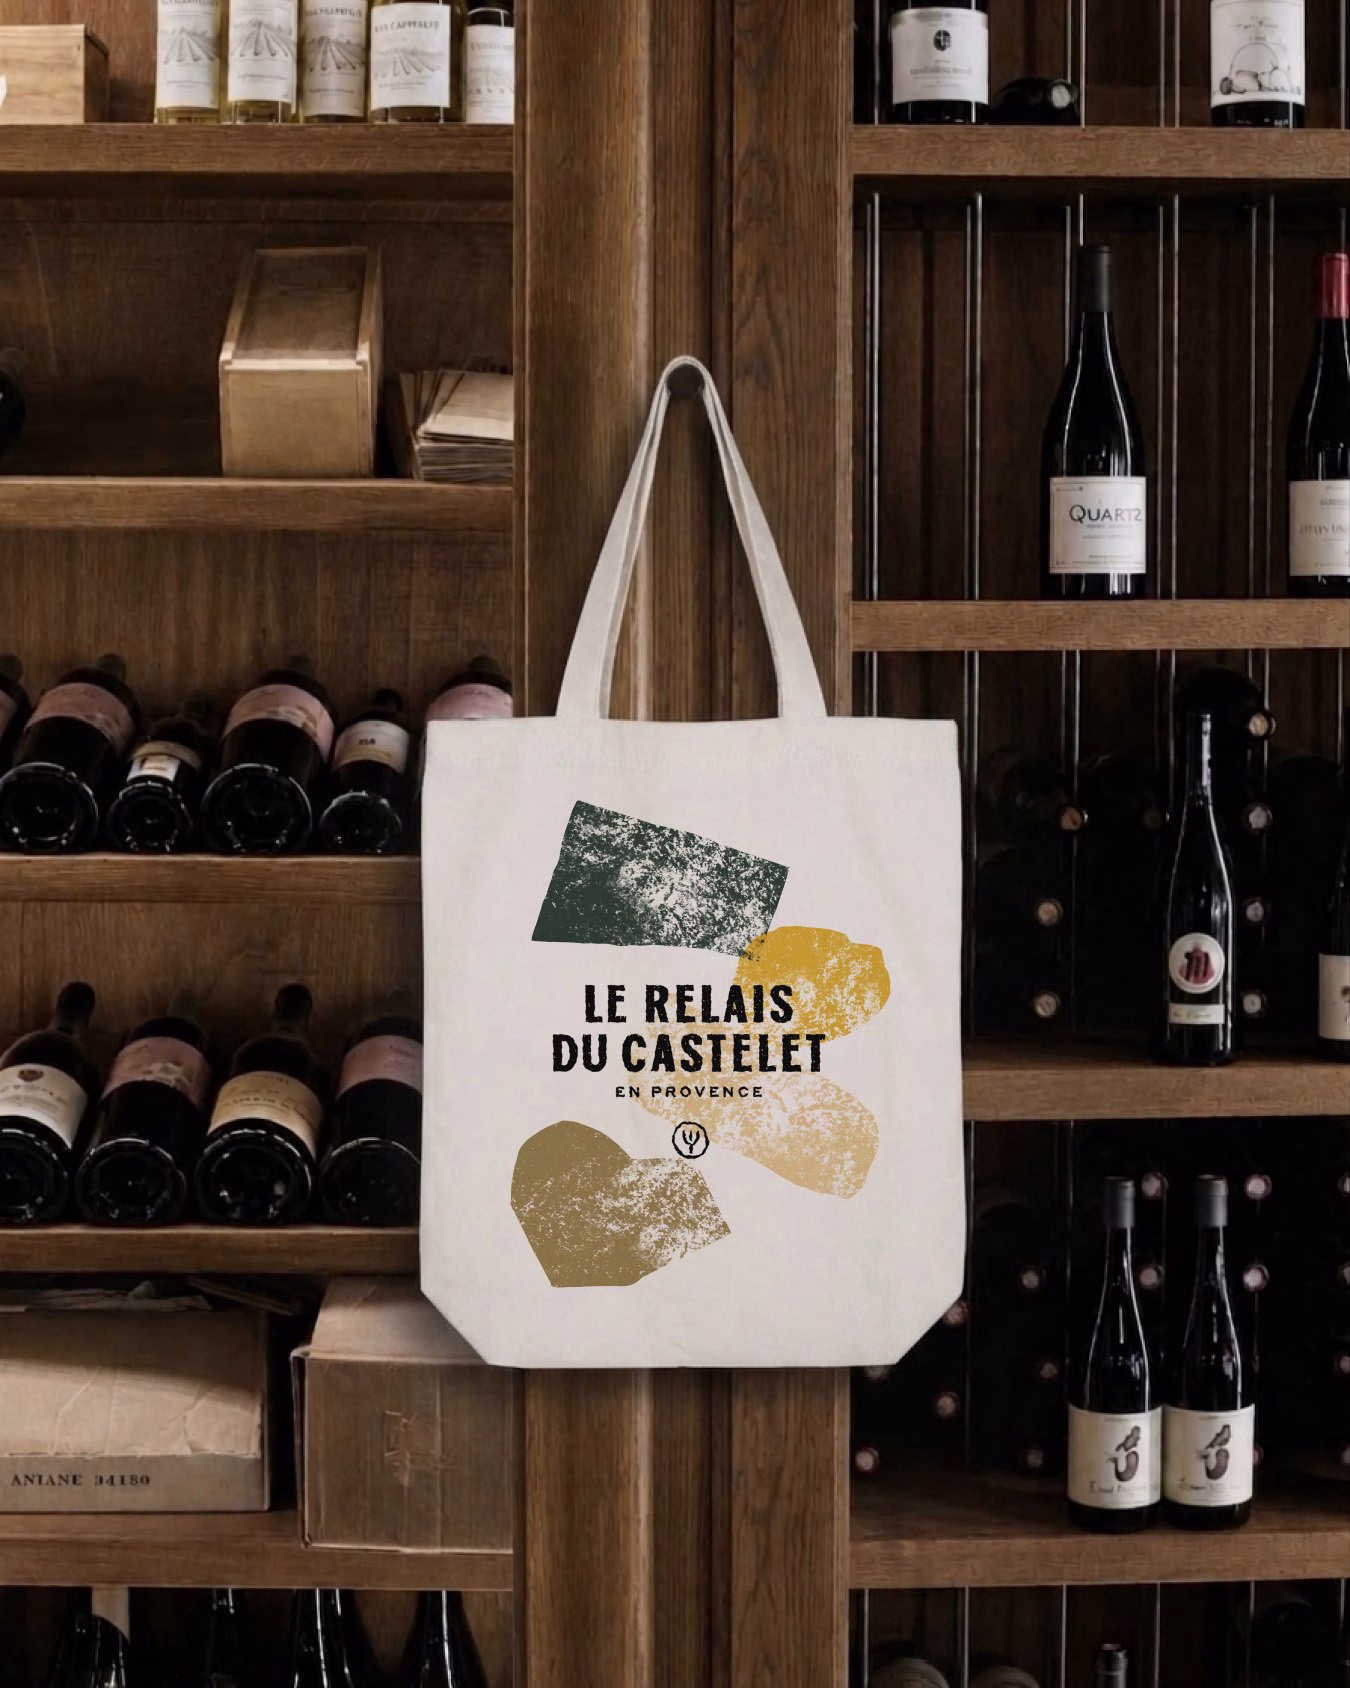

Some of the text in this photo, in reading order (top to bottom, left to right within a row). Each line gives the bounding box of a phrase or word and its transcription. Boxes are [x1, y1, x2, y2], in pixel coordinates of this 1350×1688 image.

[584, 984, 794, 1023] LE RELAIS
[552, 1033, 826, 1073] DU CASTELET
[615, 1086, 763, 1098] EN PROVENCE
[11, 1474, 82, 1486] ANIANE
